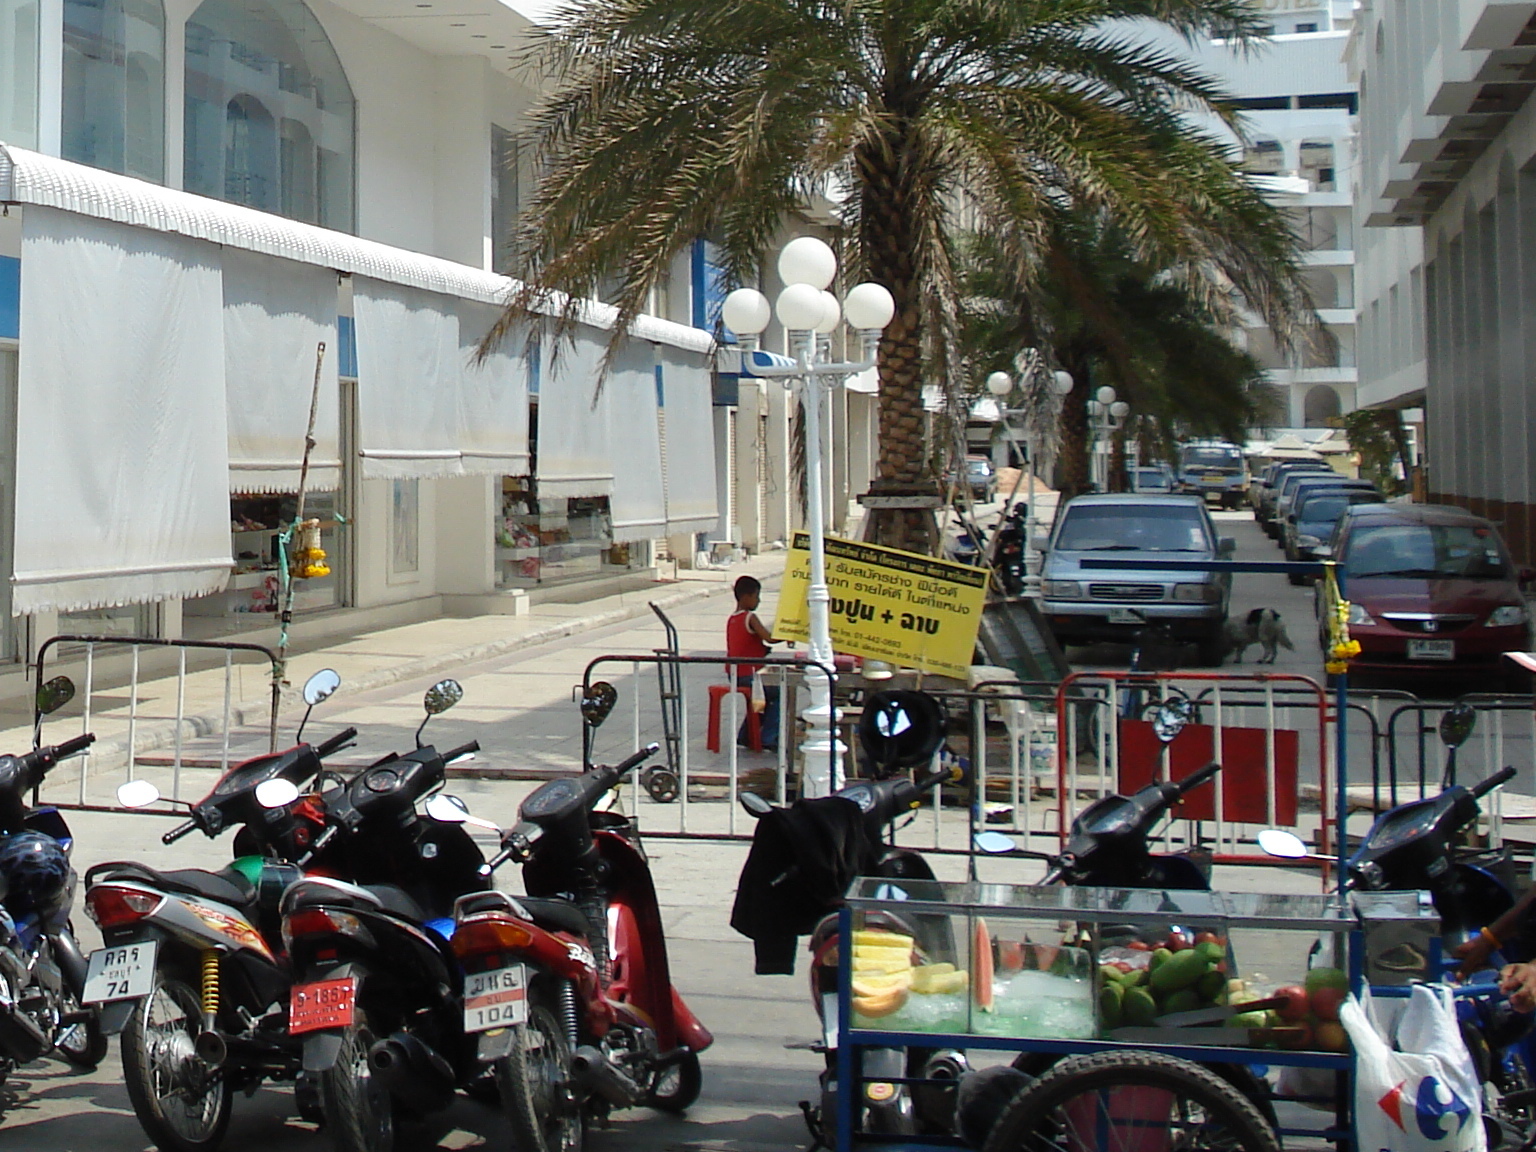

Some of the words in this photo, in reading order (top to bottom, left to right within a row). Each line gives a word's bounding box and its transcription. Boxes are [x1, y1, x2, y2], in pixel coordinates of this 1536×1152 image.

[900, 612, 940, 635] ฉาบ
[106, 980, 130, 997] 74
[477, 1004, 515, 1025] 104
